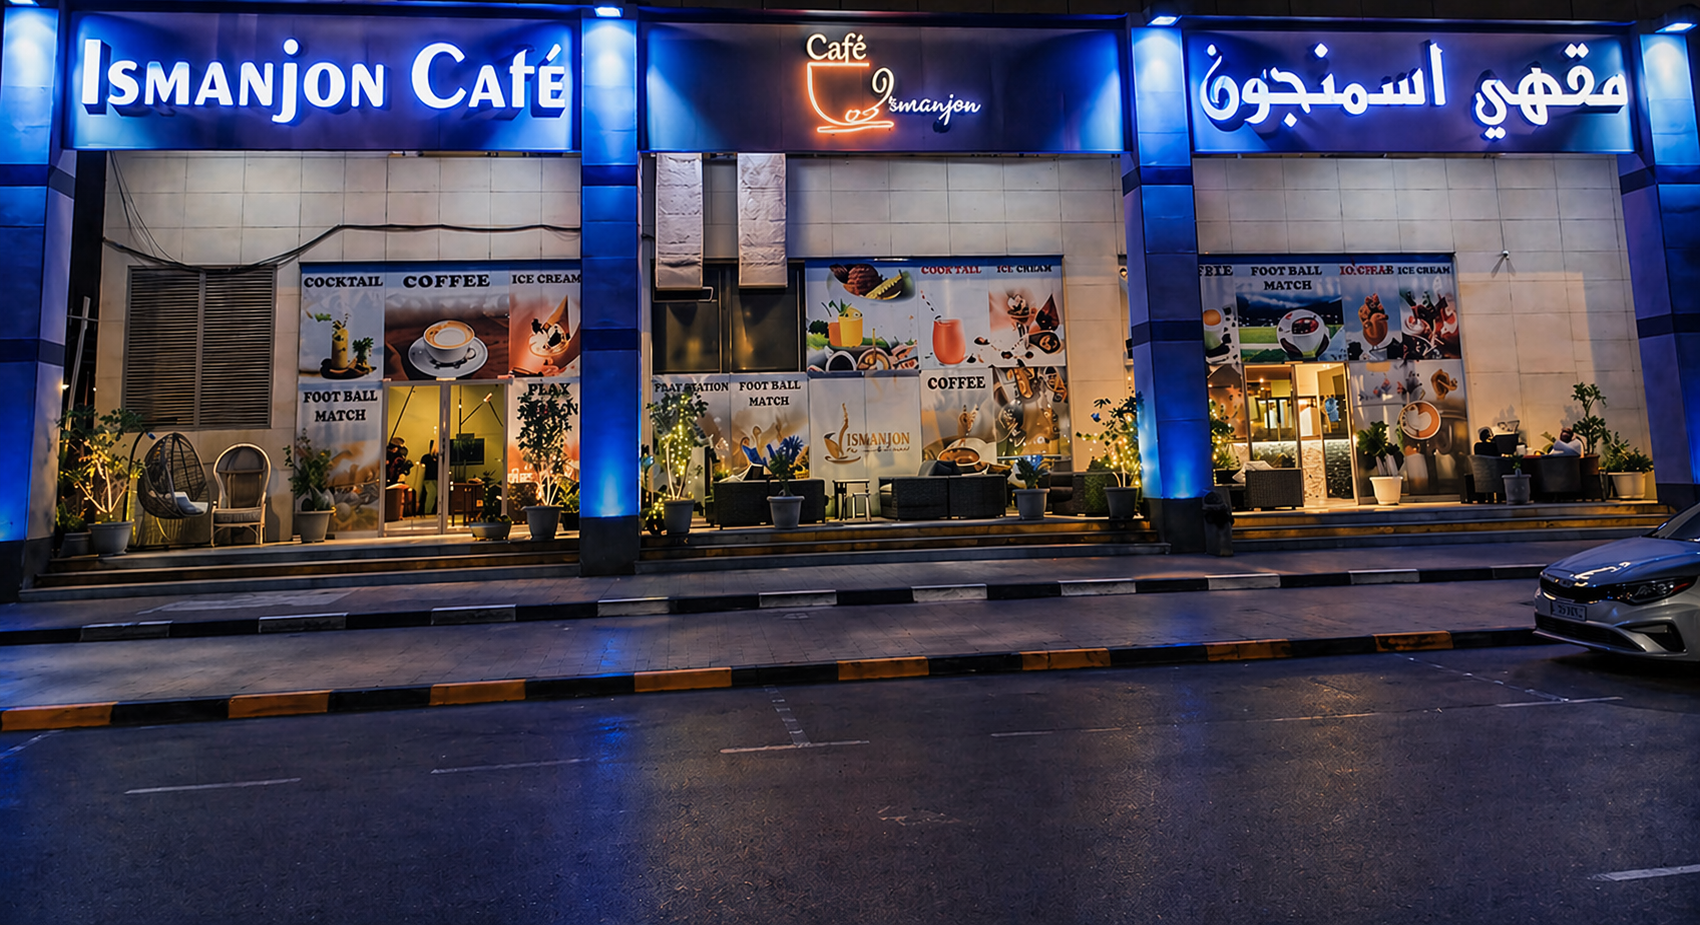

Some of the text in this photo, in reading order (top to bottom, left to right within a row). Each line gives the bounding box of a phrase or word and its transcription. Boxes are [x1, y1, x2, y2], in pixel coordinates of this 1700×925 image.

[806, 32, 867, 63] Café
[1201, 42, 1447, 127] اسمنجون
[1251, 265, 1322, 276] FOOT BALL
[1397, 266, 1415, 275] ICE
[303, 275, 384, 288] COCKTAIL
[402, 273, 490, 288] COFFEE
[511, 273, 581, 285] ICE CREAM
[1263, 280, 1312, 291] MATCH
[739, 380, 801, 391] FOOT BALL
[927, 376, 986, 390] COFFEE
[303, 389, 378, 404] FOOT BALL
[749, 396, 789, 407] MATCH
[314, 409, 366, 422] MATCH
[847, 432, 910, 448] ISMANJON
